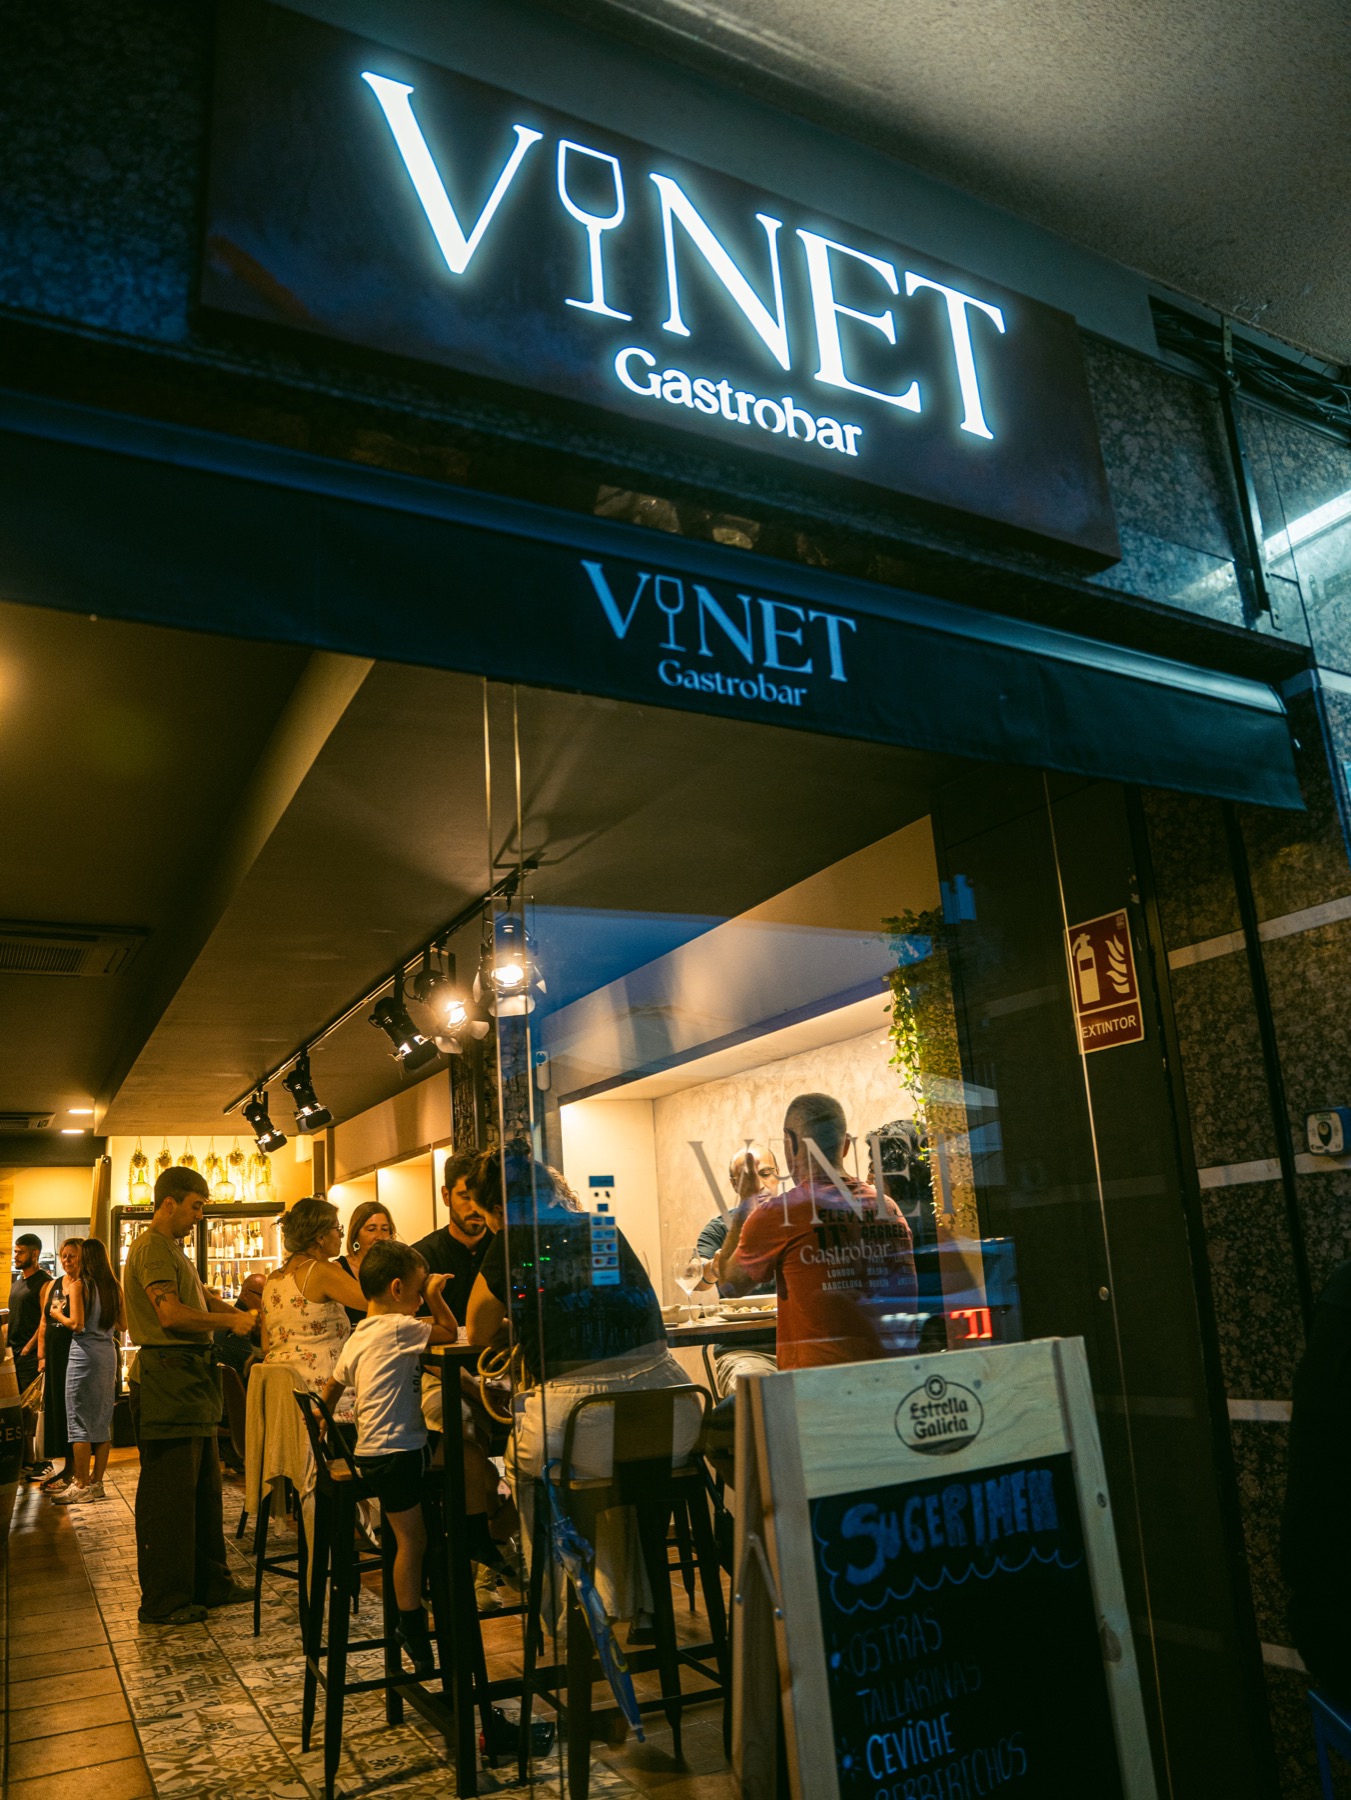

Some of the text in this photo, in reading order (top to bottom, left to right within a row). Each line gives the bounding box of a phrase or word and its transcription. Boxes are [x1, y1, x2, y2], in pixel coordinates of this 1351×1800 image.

[361, 71, 1006, 440] VINET
[614, 347, 863, 456] Gastrobar
[580, 559, 857, 682] VINET
[658, 658, 808, 707] Gastrobar
[1081, 1014, 1137, 1039] EXTINTOR
[799, 1239, 891, 1265] Gastrobar
[822, 1279, 863, 1291] BARCELONA
[826, 1267, 855, 1279] LONDON
[910, 1397, 969, 1420] Estrella
[913, 1416, 969, 1439] Galicia
[849, 1607, 944, 1678] OSTRAS
